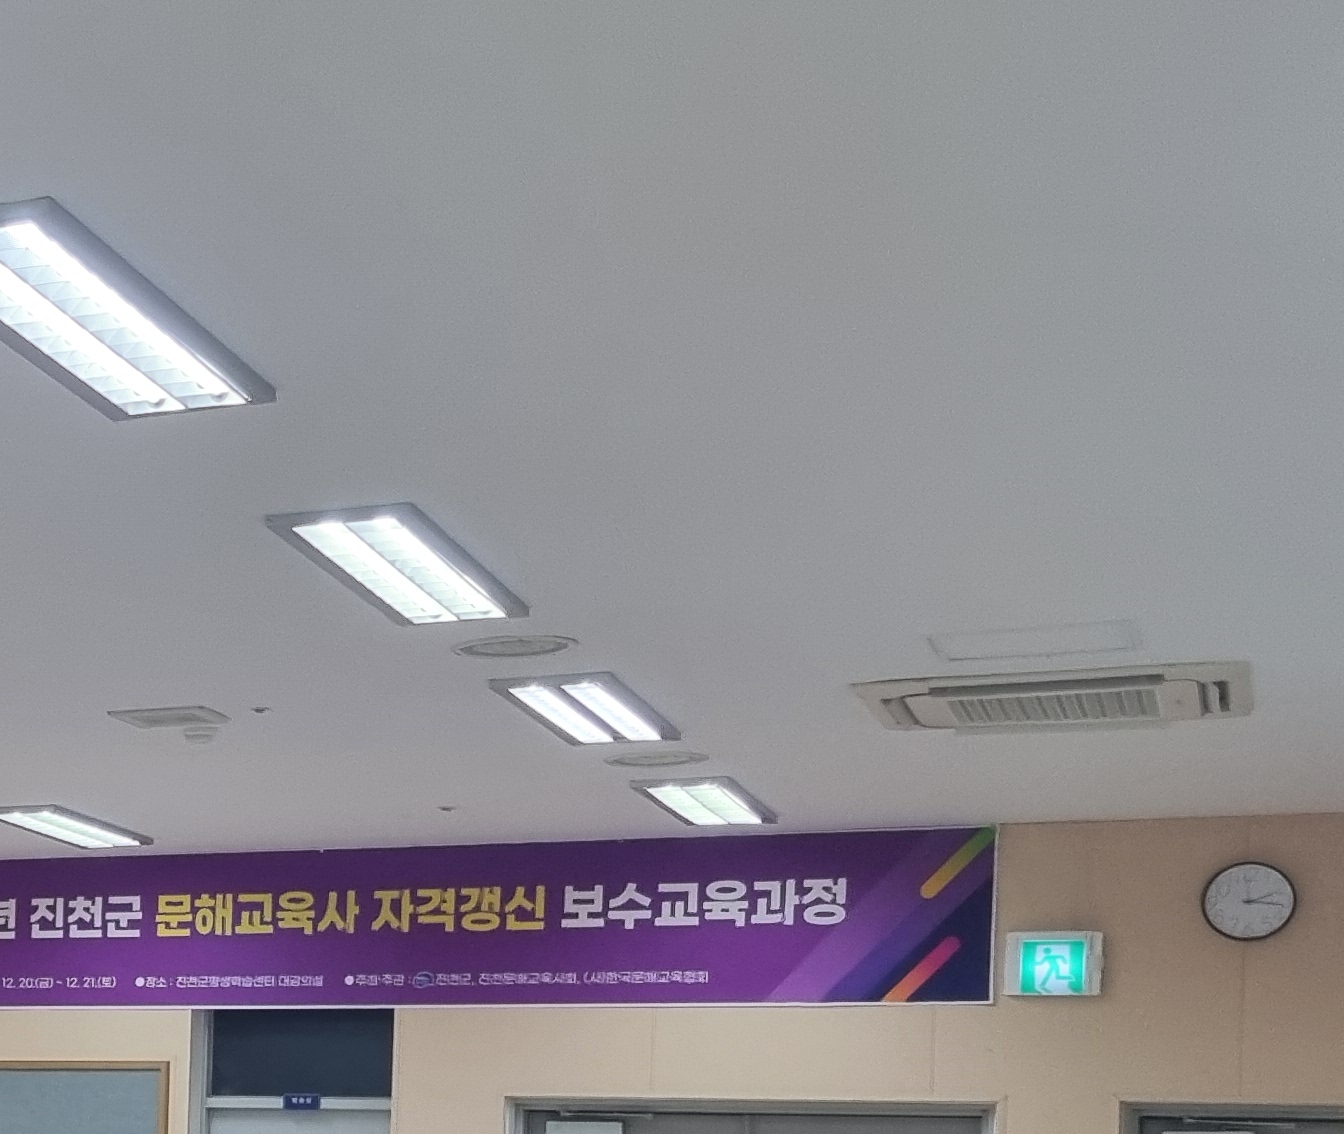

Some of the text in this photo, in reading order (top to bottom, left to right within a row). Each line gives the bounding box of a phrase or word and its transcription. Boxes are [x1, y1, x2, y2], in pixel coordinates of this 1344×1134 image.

[30, 895, 143, 938] 진천군
[155, 891, 359, 937] 문해교육사
[371, 885, 546, 933] 자격갱신
[561, 878, 847, 929] 보수교육과정
